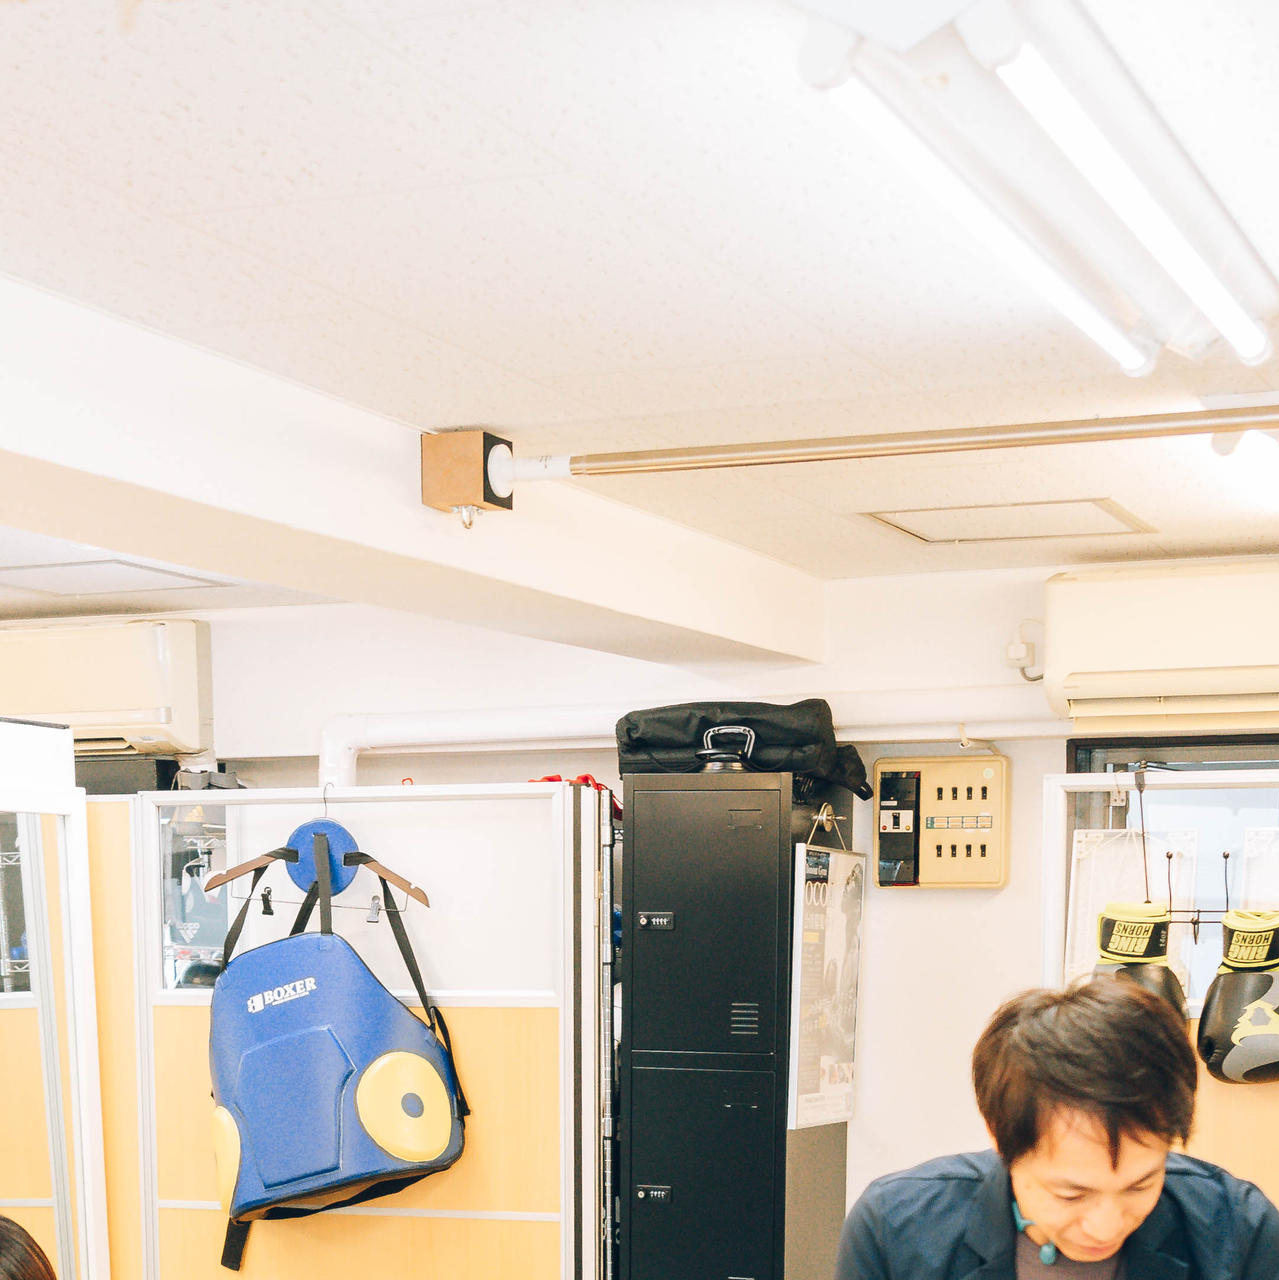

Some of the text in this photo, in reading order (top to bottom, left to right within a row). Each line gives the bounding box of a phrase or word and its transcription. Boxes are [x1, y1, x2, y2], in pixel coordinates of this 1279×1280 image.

[1115, 922, 1152, 937] HORNS
[1108, 934, 1150, 953] RING
[1234, 933, 1271, 945] HORNS
[1228, 943, 1270, 960] RING
[263, 977, 317, 1005] BOXER
